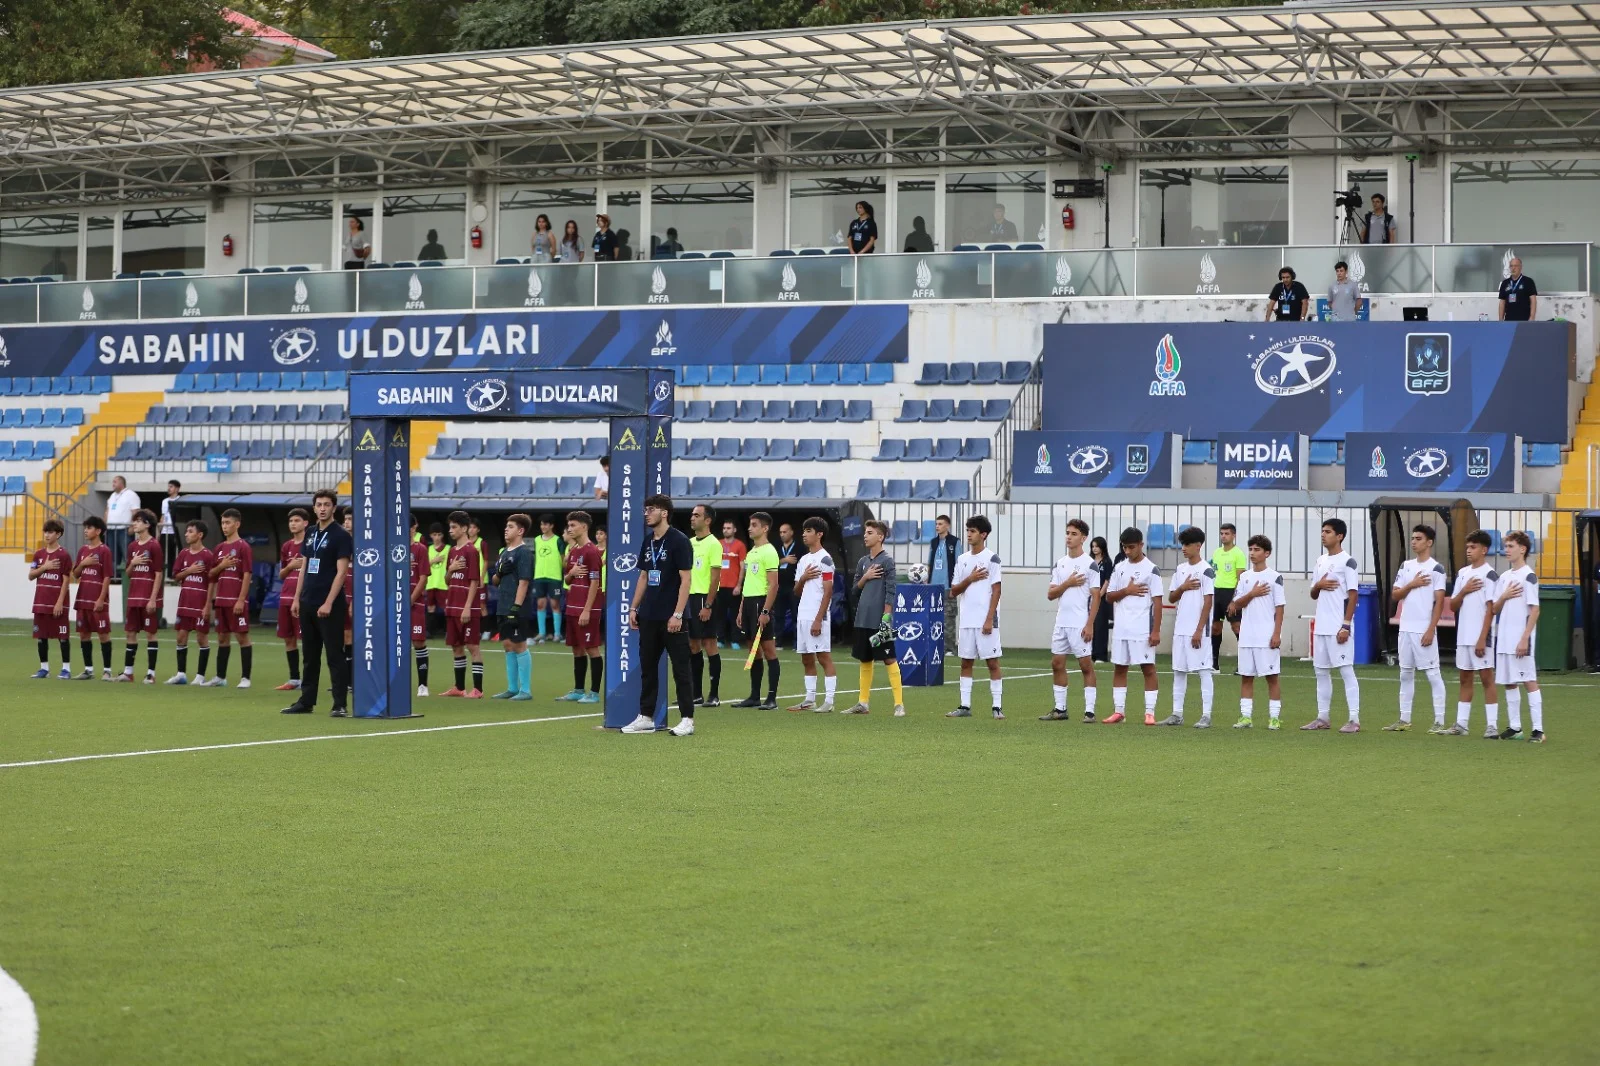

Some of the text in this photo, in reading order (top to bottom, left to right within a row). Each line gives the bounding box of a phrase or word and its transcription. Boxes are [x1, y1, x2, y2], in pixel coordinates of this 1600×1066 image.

[912, 288, 936, 298] AFFA
[1052, 285, 1076, 296] AFFA
[1196, 284, 1221, 294] AFFA
[648, 294, 670, 304] AFFA
[777, 291, 800, 301] AFFA
[405, 301, 425, 309] AFFA
[524, 297, 545, 306] AFFA
[182, 307, 201, 317] AFFA
[290, 304, 311, 313] AFFA
[79, 311, 97, 320] AFFA
[98, 332, 245, 365] SABAHIN
[337, 324, 540, 360] ULDUZLARI
[651, 347, 677, 356] BFF
[1251, 335, 1336, 370] SABAHIN ULDUZLARI
[1149, 380, 1187, 396] AFFA
[1411, 379, 1444, 388] BFF
[377, 386, 453, 405] SABAHIN
[520, 384, 618, 403] ULDUZLARI
[1034, 466, 1053, 474] AFFA
[1224, 469, 1248, 478] BAYIL
[364, 463, 373, 540] SABAHIN
[621, 464, 631, 545] SABAHIN
[364, 573, 373, 671] ULDUZLARI
[59, 625, 67, 634] 10
[413, 625, 422, 634] 99
[620, 579, 630, 682] ULDUZLARI
[585, 632, 591, 642] 7
